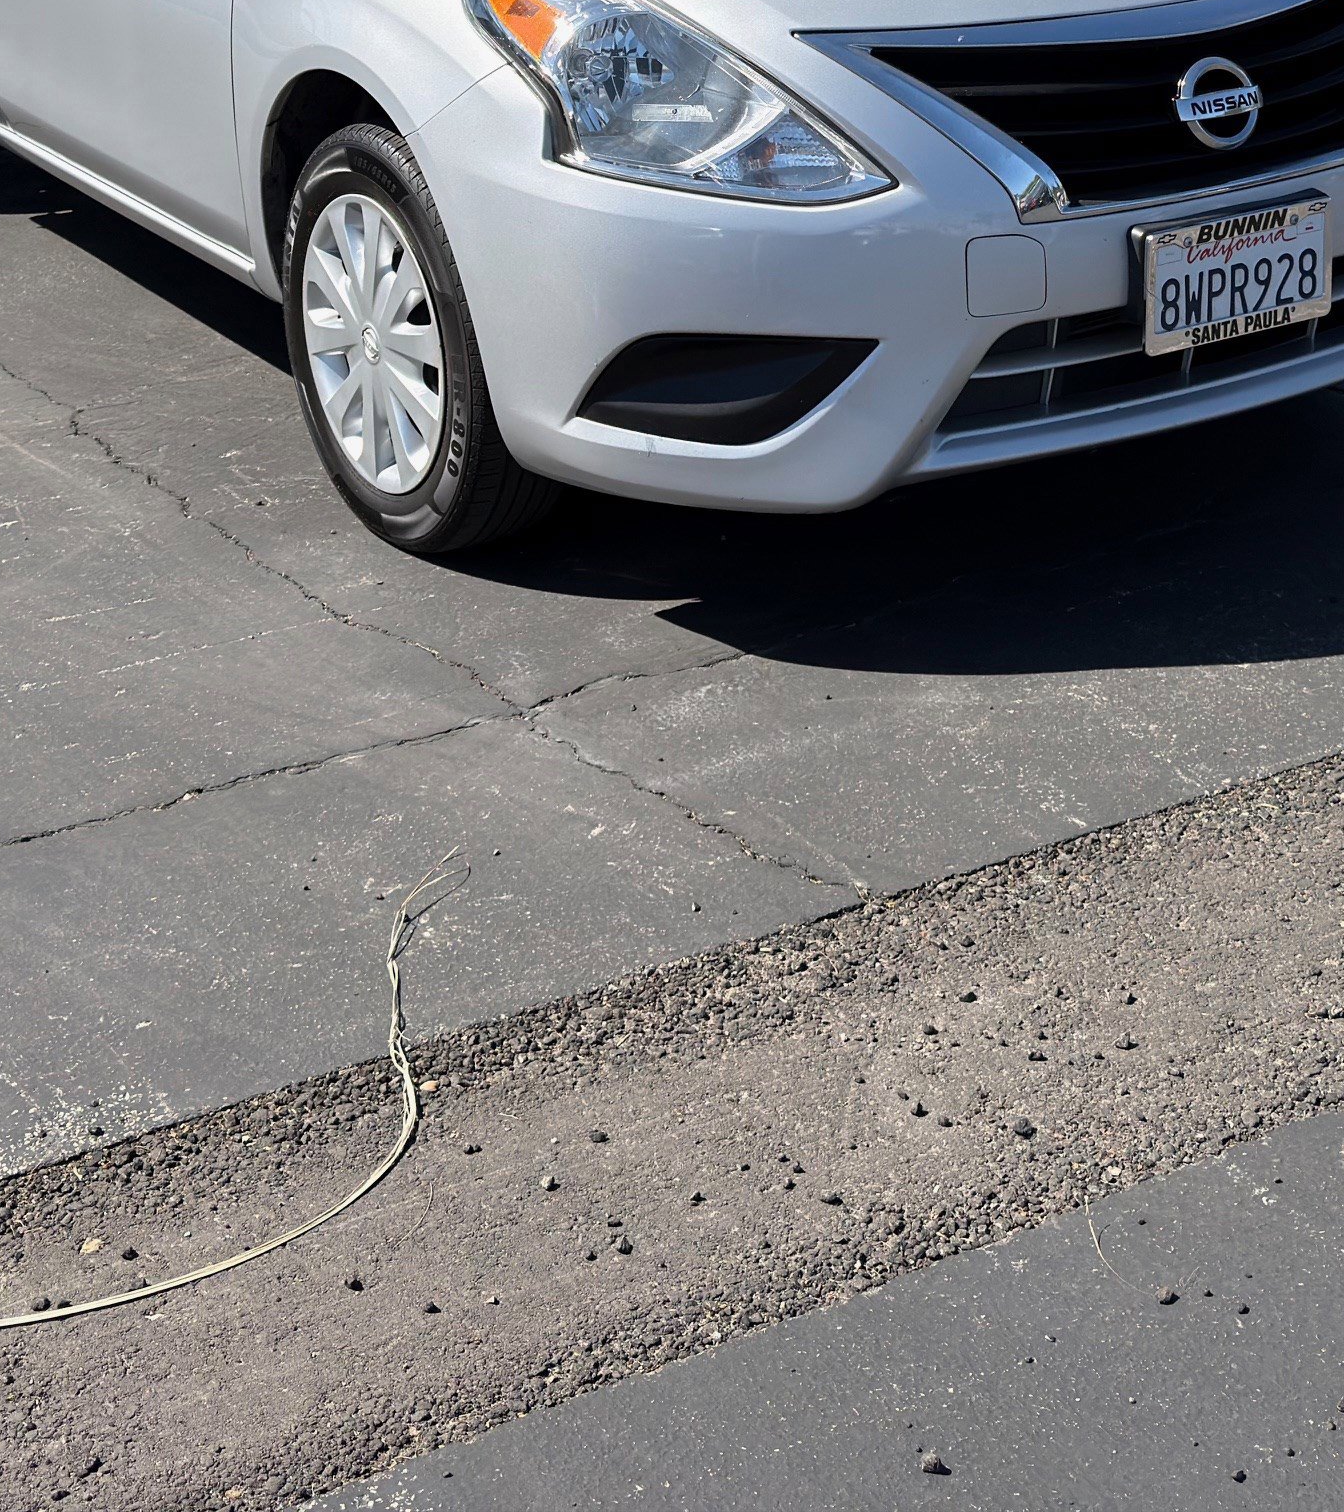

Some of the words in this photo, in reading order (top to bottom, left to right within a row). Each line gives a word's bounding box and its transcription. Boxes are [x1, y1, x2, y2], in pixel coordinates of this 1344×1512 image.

[1190, 90, 1259, 117] NISSAN
[1196, 208, 1289, 245] BUNNIN
[1186, 227, 1297, 265] California
[1159, 247, 1318, 332] 8WPR928
